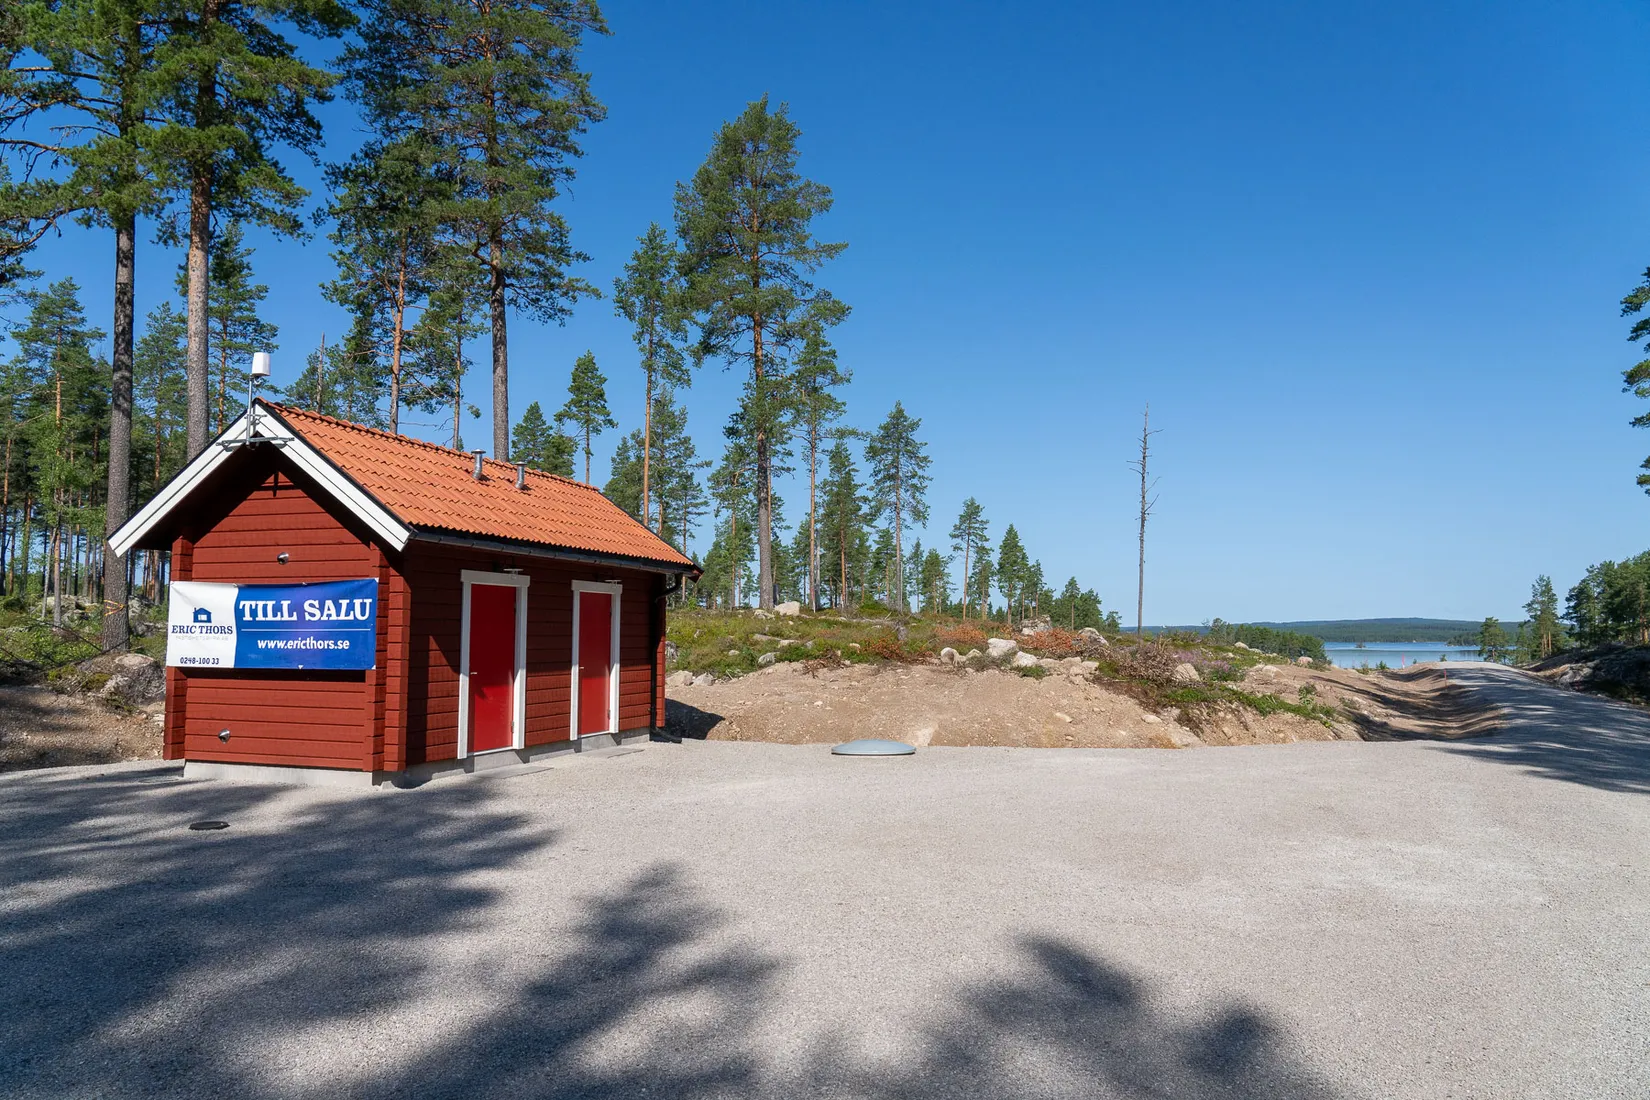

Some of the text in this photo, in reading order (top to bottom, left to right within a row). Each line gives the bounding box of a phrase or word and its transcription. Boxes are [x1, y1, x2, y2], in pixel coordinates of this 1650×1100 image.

[239, 598, 372, 621] TILL SALU
[171, 625, 233, 634] ERIC THORS
[257, 636, 349, 649] www.ericthors.se
[179, 656, 220, 665] 0248-100 33
